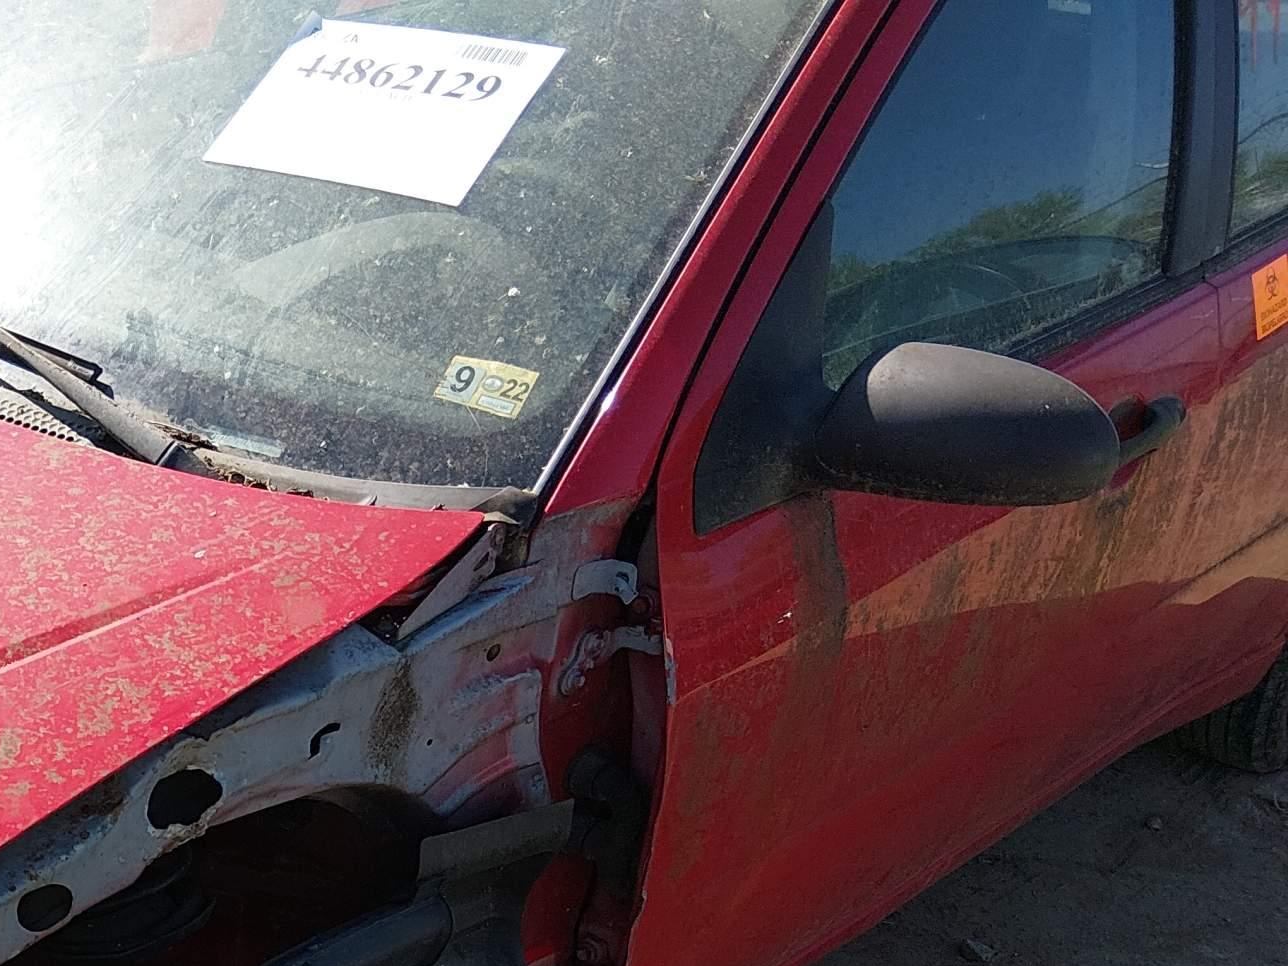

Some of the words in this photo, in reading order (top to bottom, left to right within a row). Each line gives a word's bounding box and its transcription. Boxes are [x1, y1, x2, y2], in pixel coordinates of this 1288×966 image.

[297, 54, 502, 101] 44862129
[450, 366, 476, 392] 9
[499, 378, 530, 403] 22
